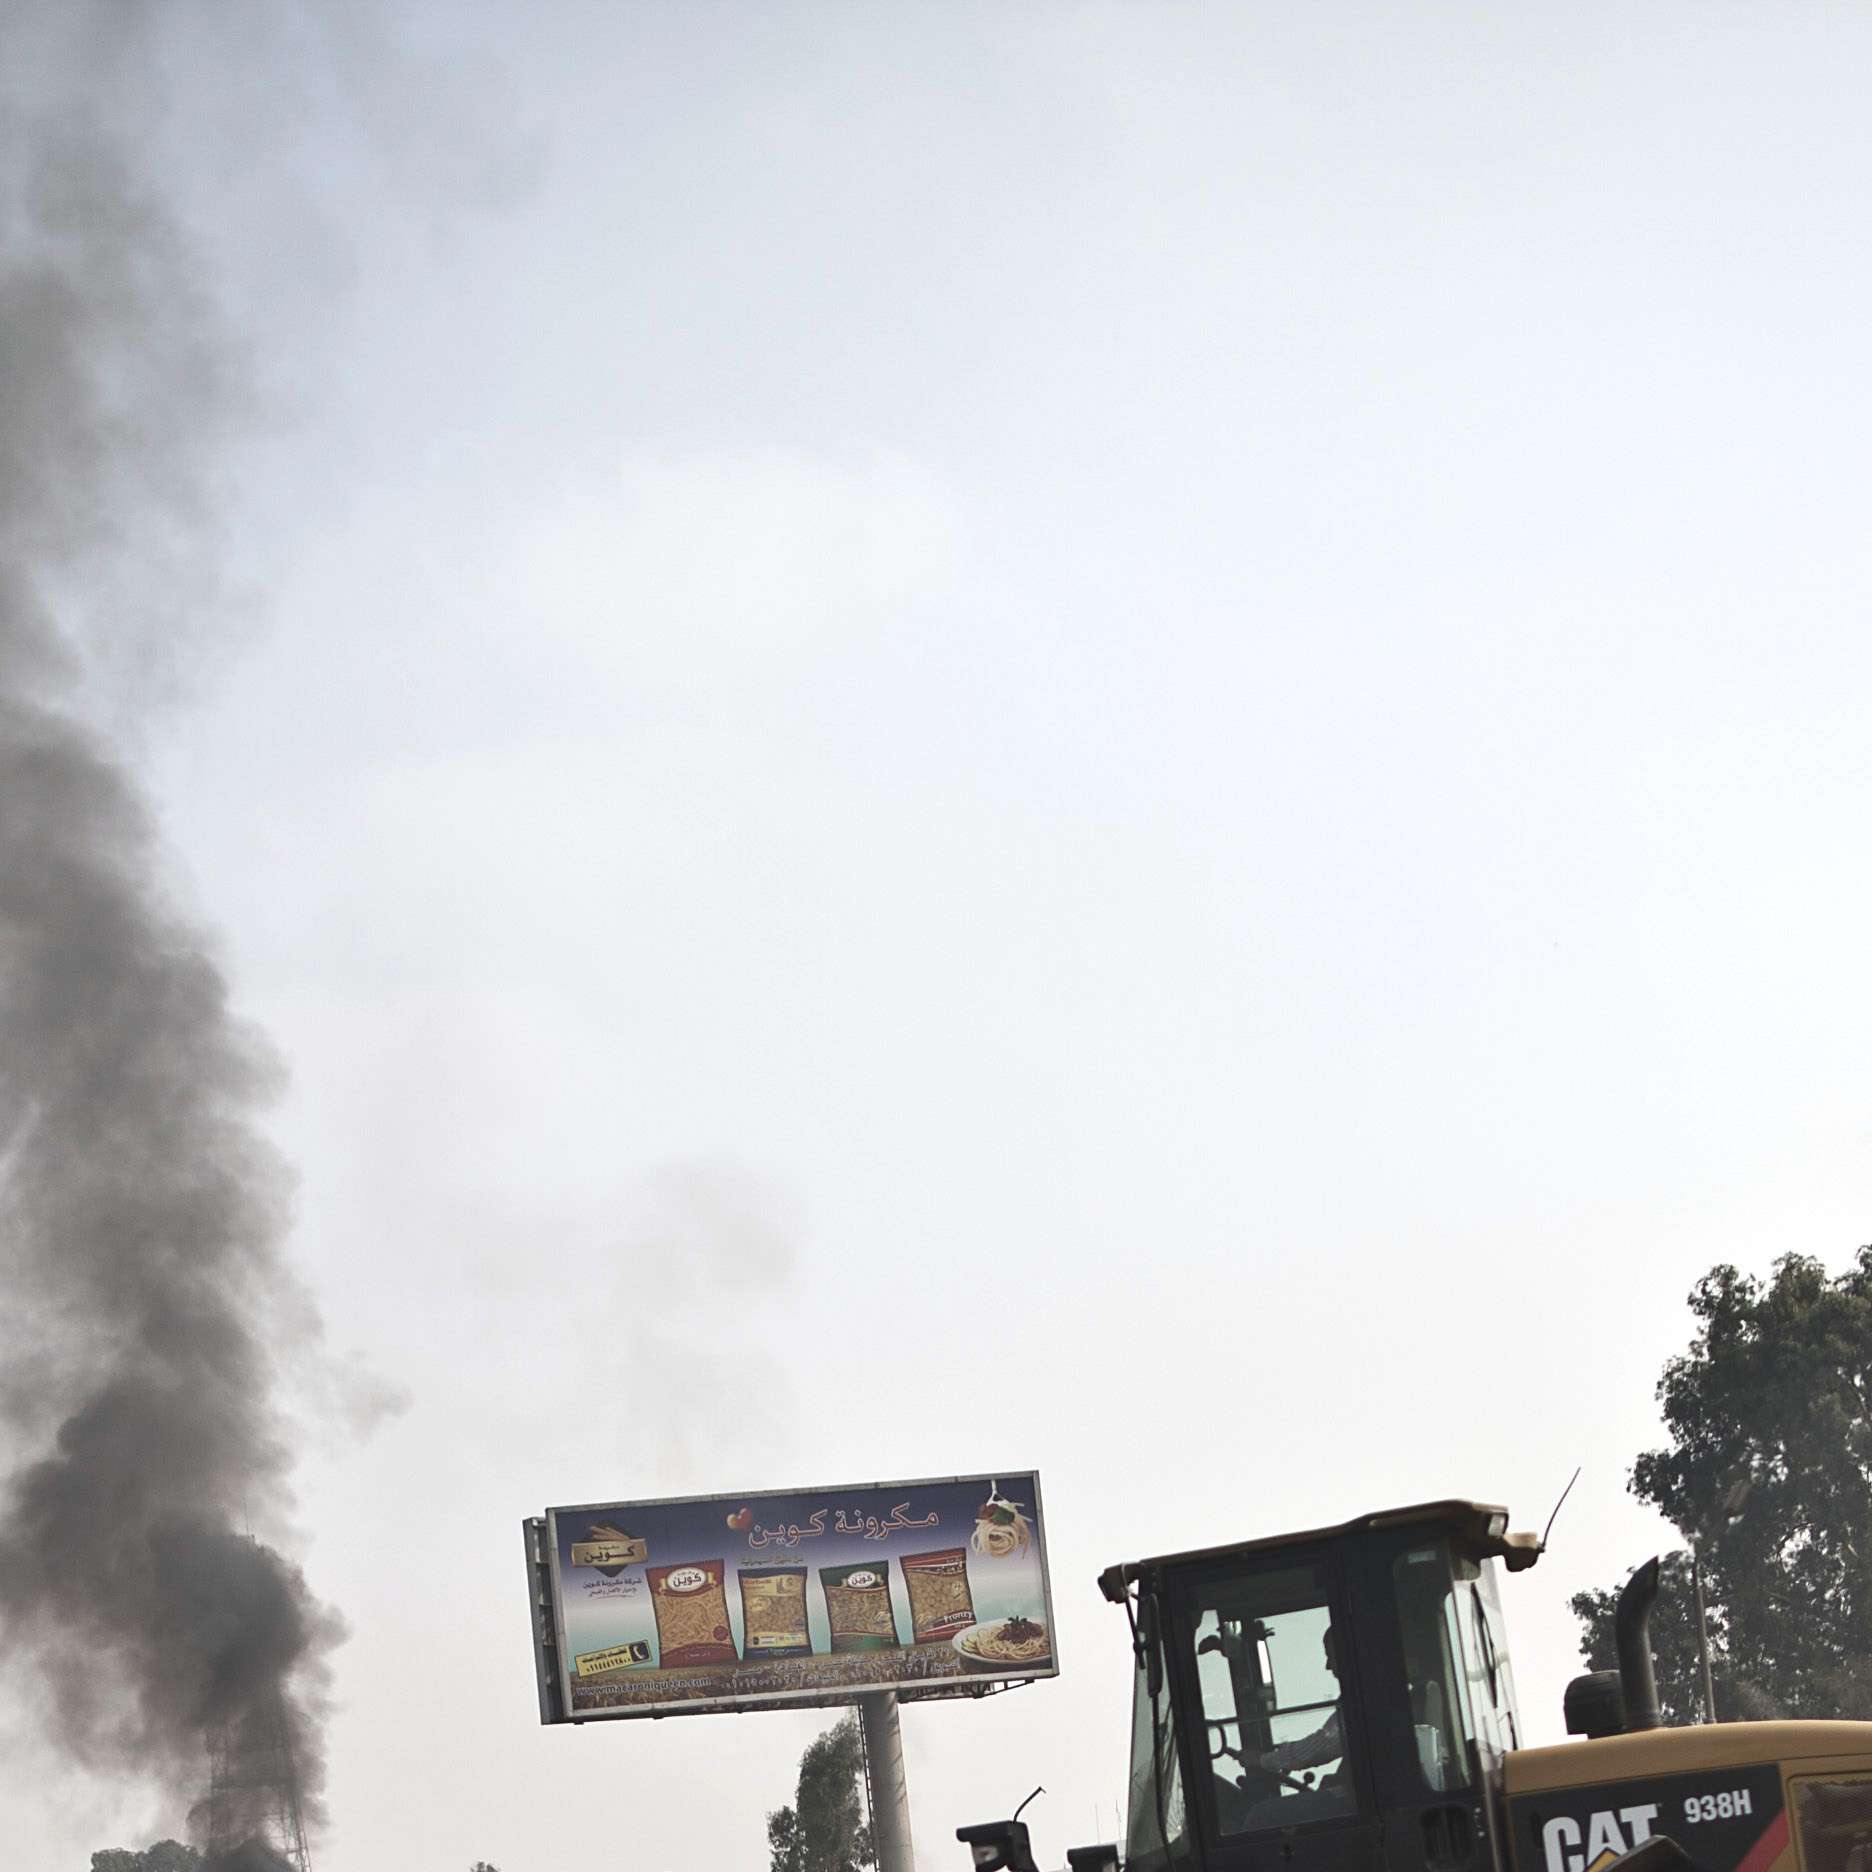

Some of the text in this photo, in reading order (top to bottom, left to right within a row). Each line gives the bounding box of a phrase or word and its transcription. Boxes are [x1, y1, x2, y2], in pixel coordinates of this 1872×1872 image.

[748, 1502, 939, 1549] مكرونة كوين
[584, 1544, 635, 1563] كوين
[672, 1572, 702, 1588] كوين
[576, 1676, 711, 1696] www.macaroniqueen.com
[1684, 1789, 1753, 1824] 938H
